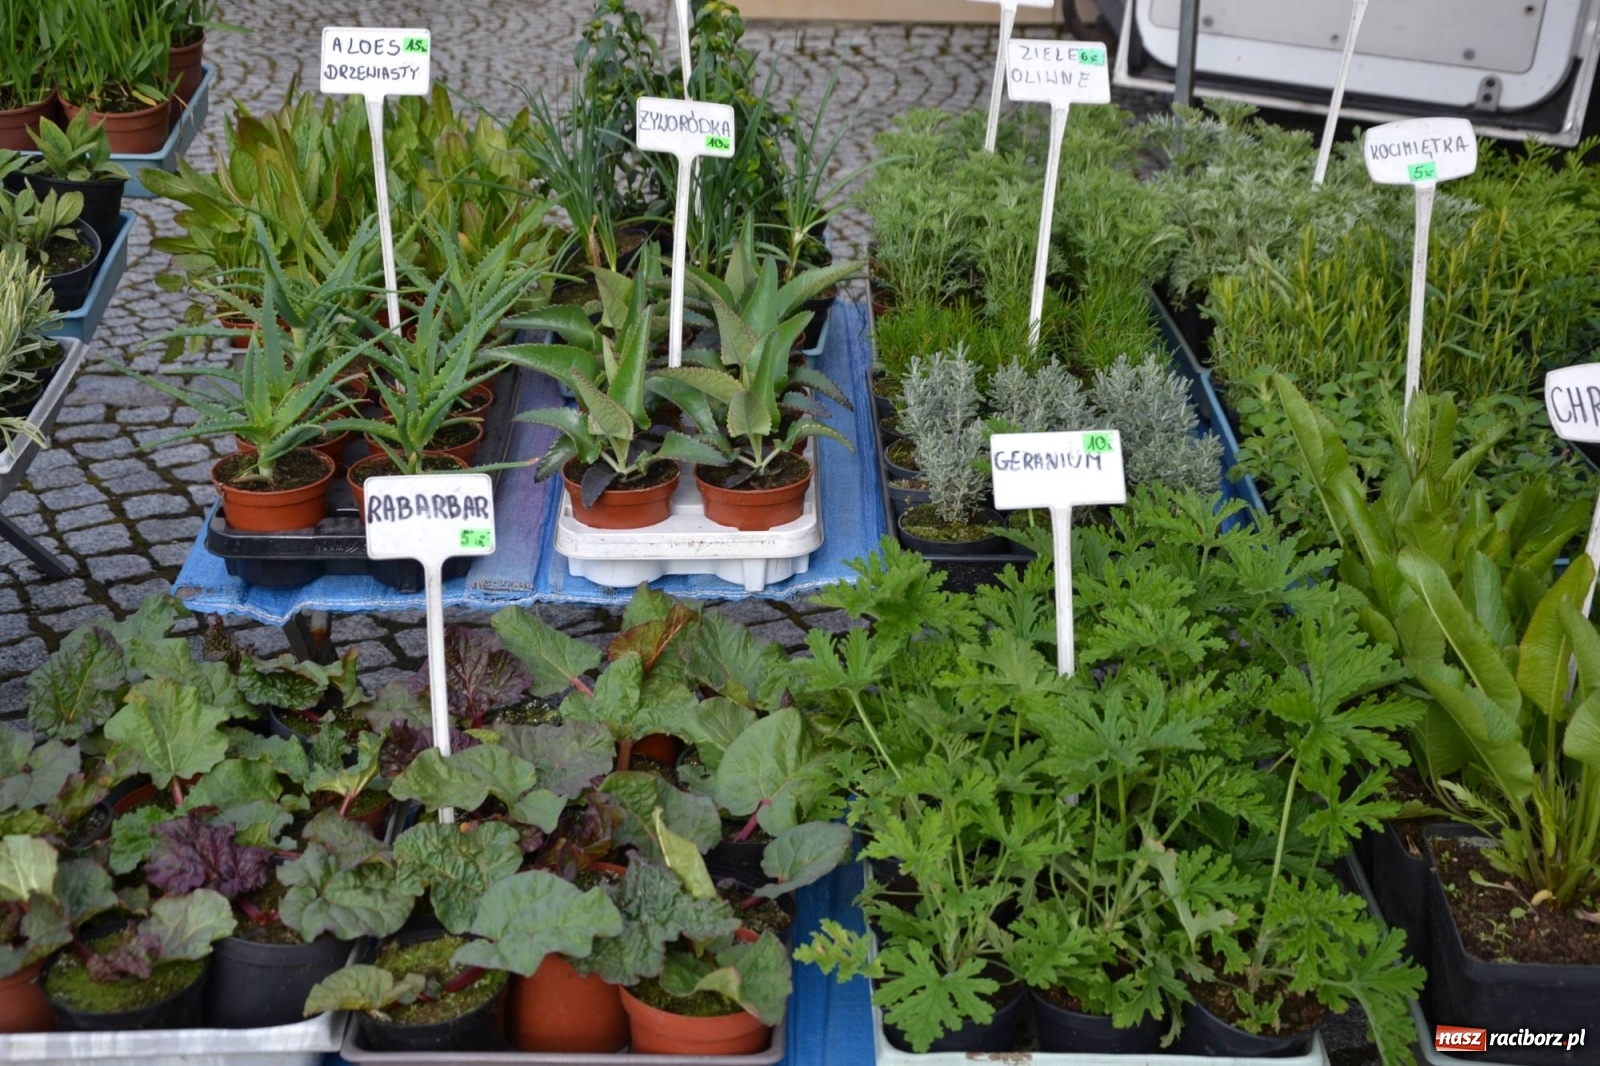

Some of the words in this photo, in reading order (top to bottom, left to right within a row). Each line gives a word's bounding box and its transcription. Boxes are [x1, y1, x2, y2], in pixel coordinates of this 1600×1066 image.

[332, 36, 401, 56] ALOES
[1019, 44, 1079, 62] ZIELE
[324, 63, 420, 80] DRZEWIASTY
[1011, 67, 1090, 88] OLIWNE
[1370, 135, 1470, 160] KOCIMIĘTKA
[994, 450, 1102, 471] GERANIUM
[366, 493, 489, 524] RABARBAR
